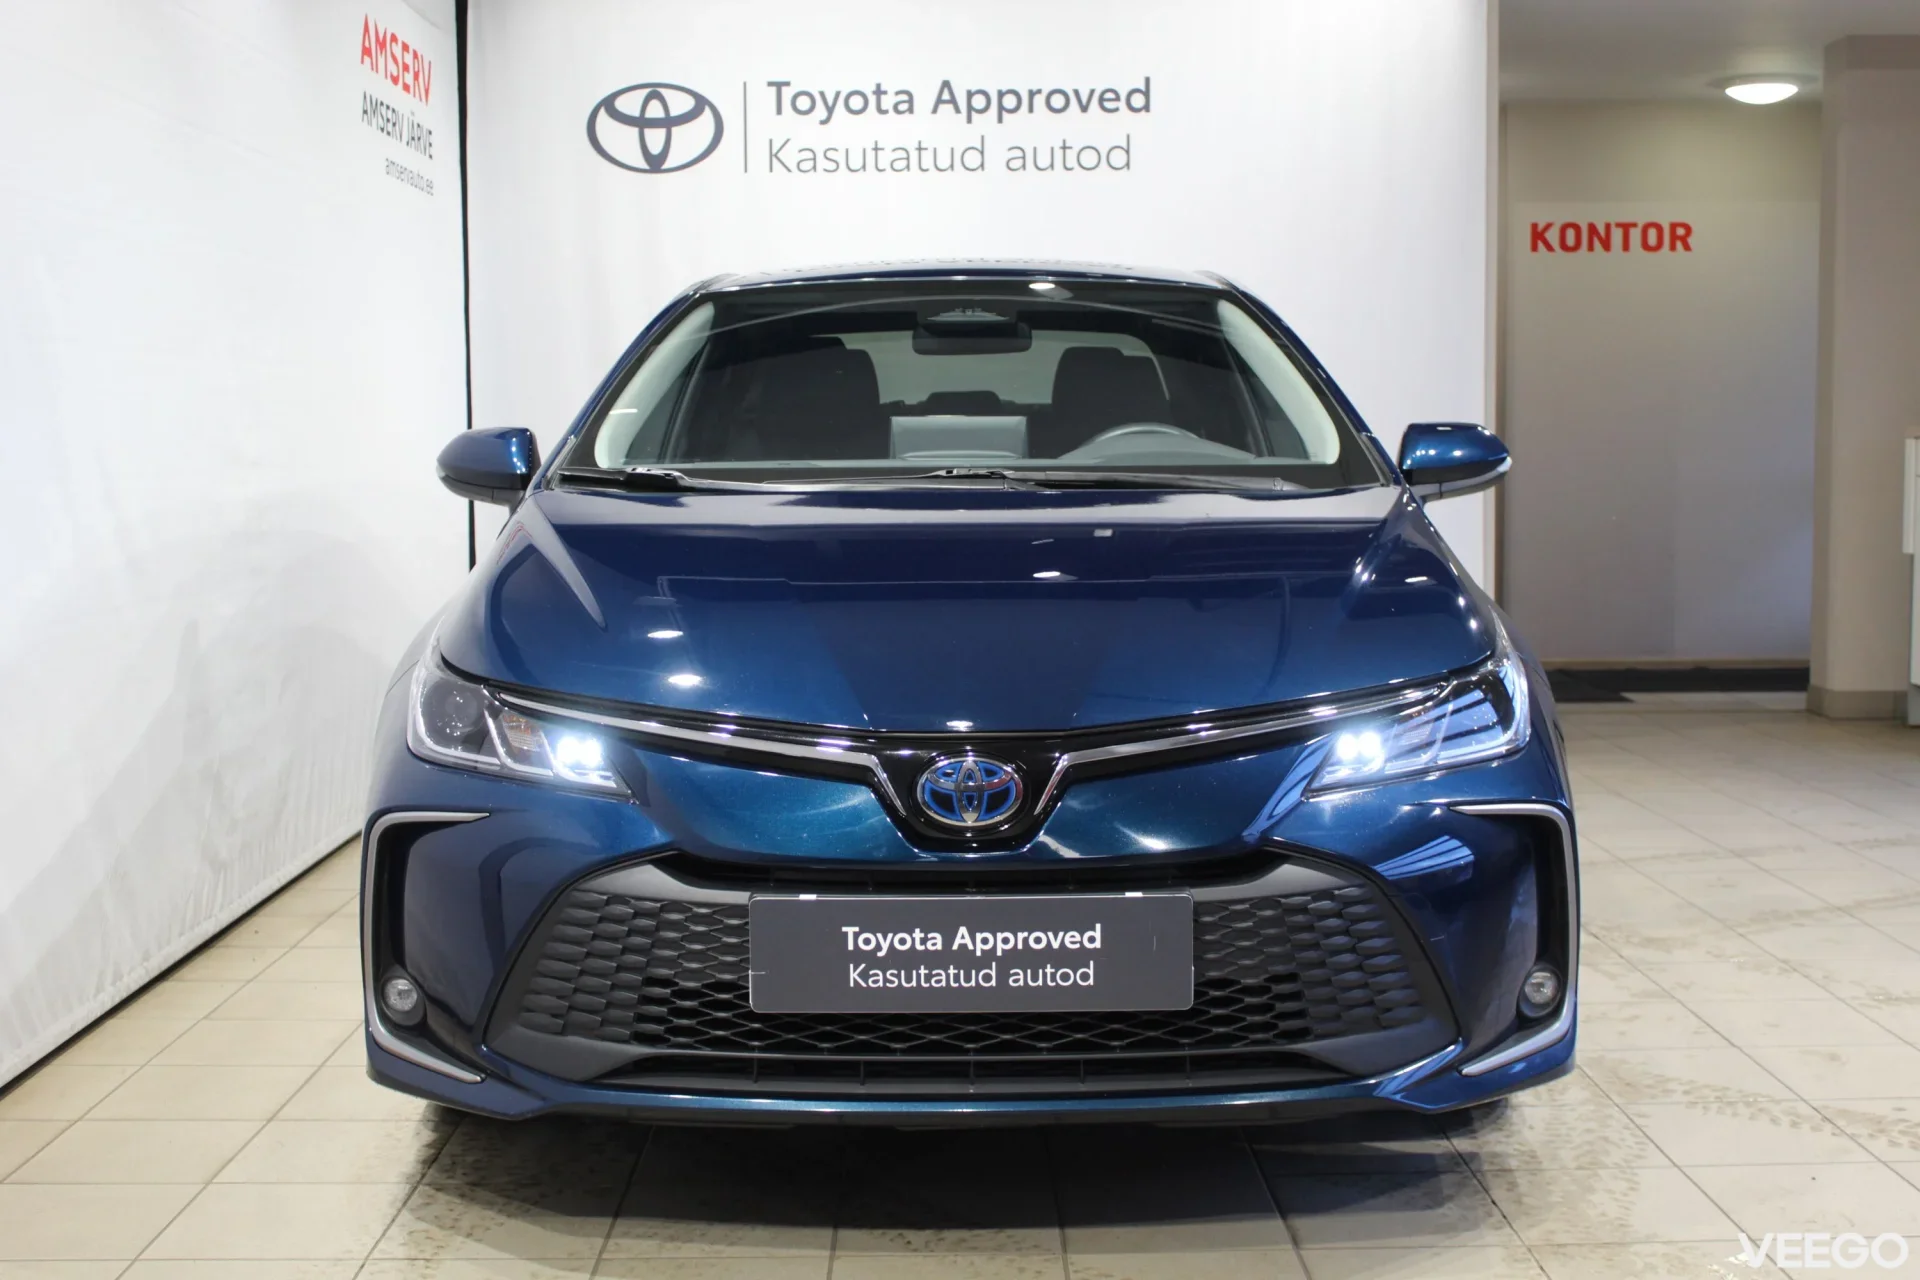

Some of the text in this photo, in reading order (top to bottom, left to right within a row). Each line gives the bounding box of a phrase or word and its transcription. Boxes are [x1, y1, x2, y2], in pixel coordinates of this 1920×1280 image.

[361, 13, 431, 106] AMSERV
[767, 77, 1152, 125] Toyota Approved
[361, 90, 433, 160] AMSERV JÄRVE
[767, 133, 1131, 173] Kasutatud autod
[385, 157, 434, 196] amservauto.ee
[1530, 222, 1693, 252] KONTOR
[842, 924, 1102, 957] Toyota Approved
[849, 961, 1095, 988] Kasutatud autod
